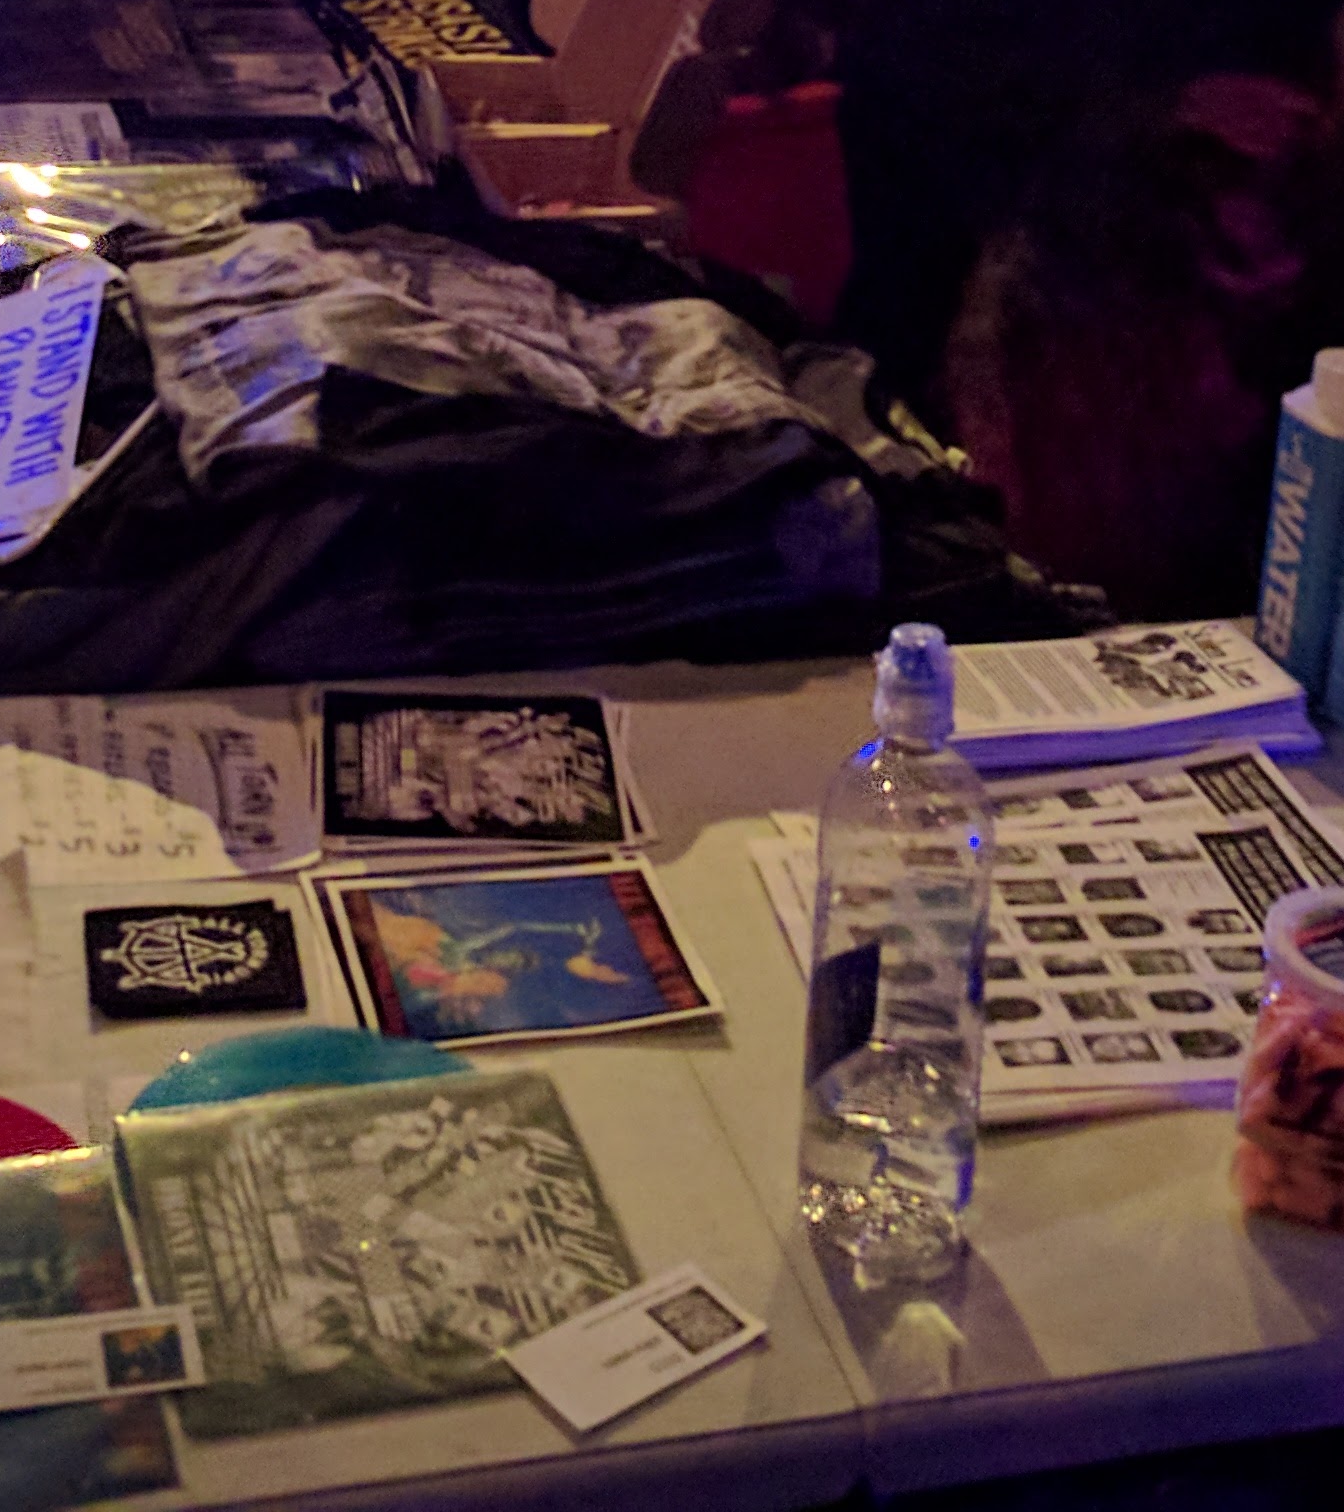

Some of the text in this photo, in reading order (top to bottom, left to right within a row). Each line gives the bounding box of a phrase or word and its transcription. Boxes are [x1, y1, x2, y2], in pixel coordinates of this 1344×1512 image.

[30, 300, 93, 399] STAND
[4, 401, 69, 487] WITH
[1255, 477, 1314, 660] WATER
